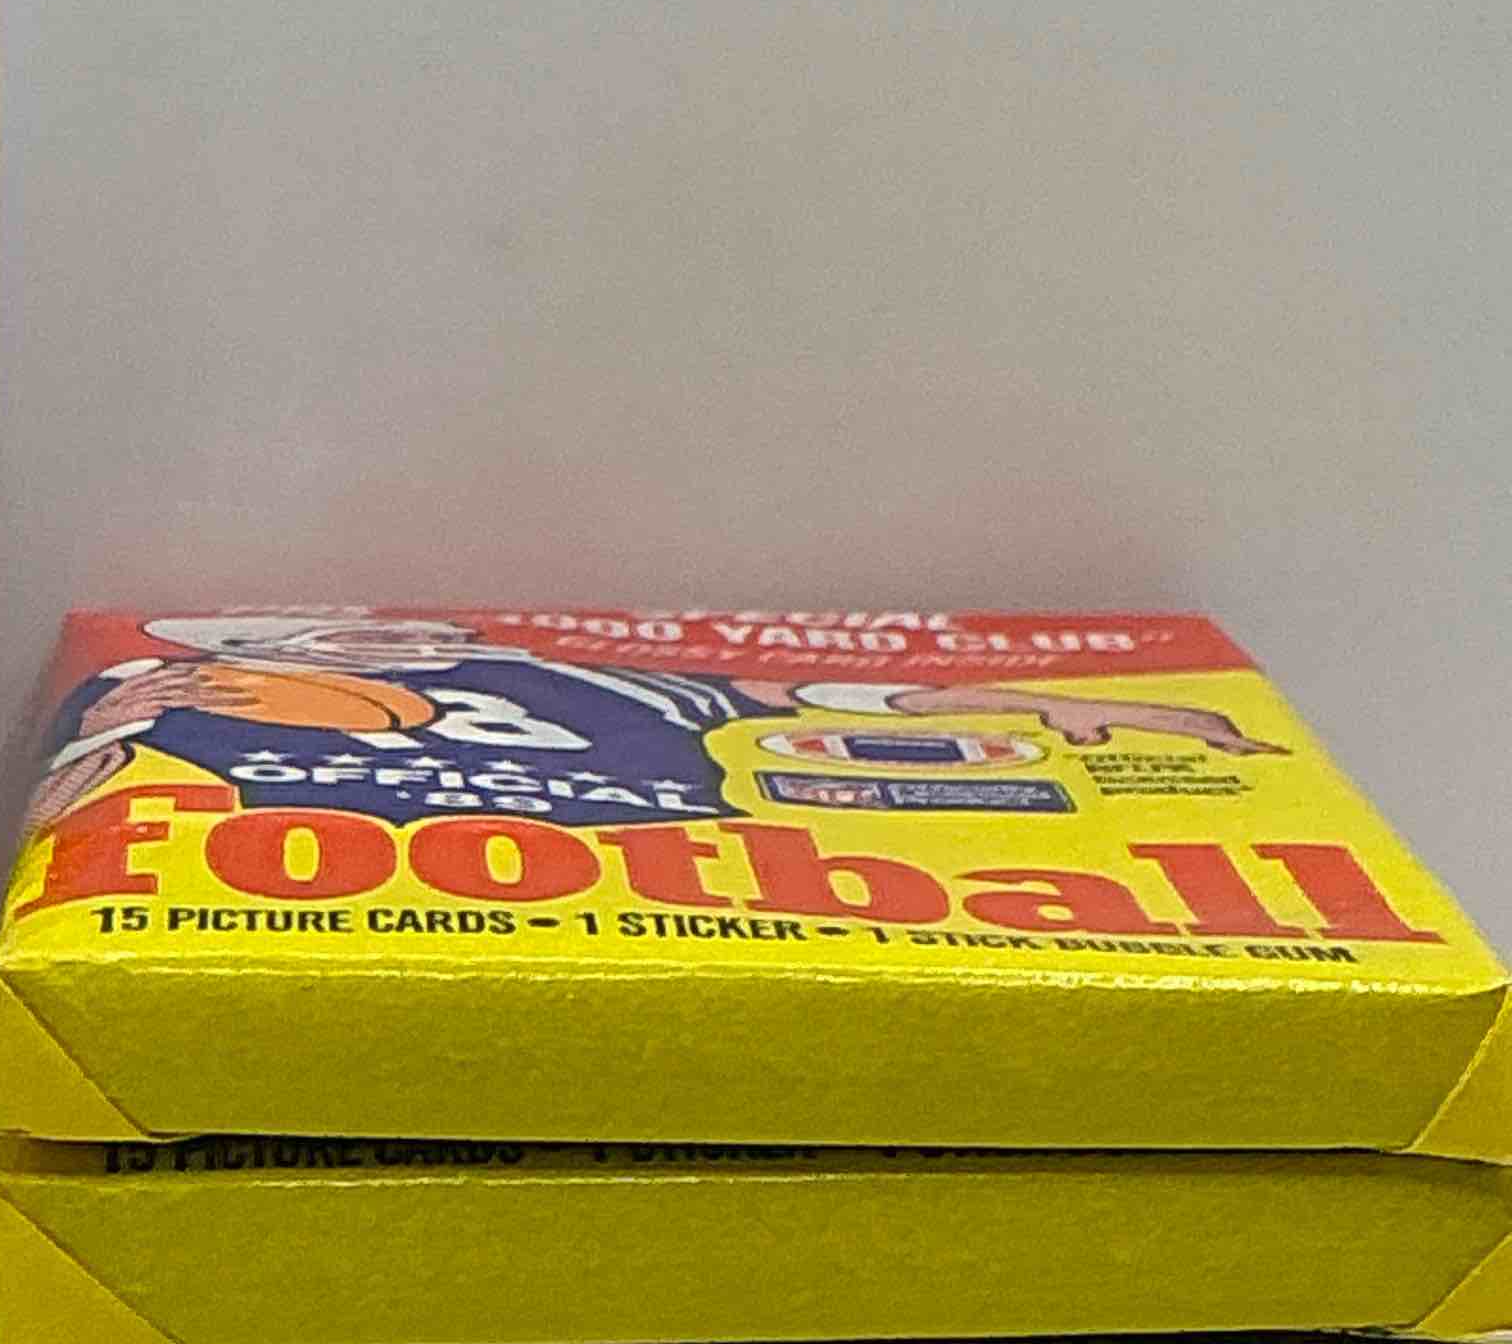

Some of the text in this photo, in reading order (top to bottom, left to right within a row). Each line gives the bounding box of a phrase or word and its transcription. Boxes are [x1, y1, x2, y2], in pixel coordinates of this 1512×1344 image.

[228, 763, 720, 816] OFFICIAL
[15, 783, 1448, 943] Football
[91, 906, 149, 934] 15
[167, 908, 354, 933] PICTURE
[367, 908, 517, 935] CARDS
[576, 912, 599, 936] 1
[618, 912, 808, 941] STICKER
[865, 926, 890, 945] 1
[905, 930, 1043, 952] STICK
[1243, 943, 1359, 964] GUM
